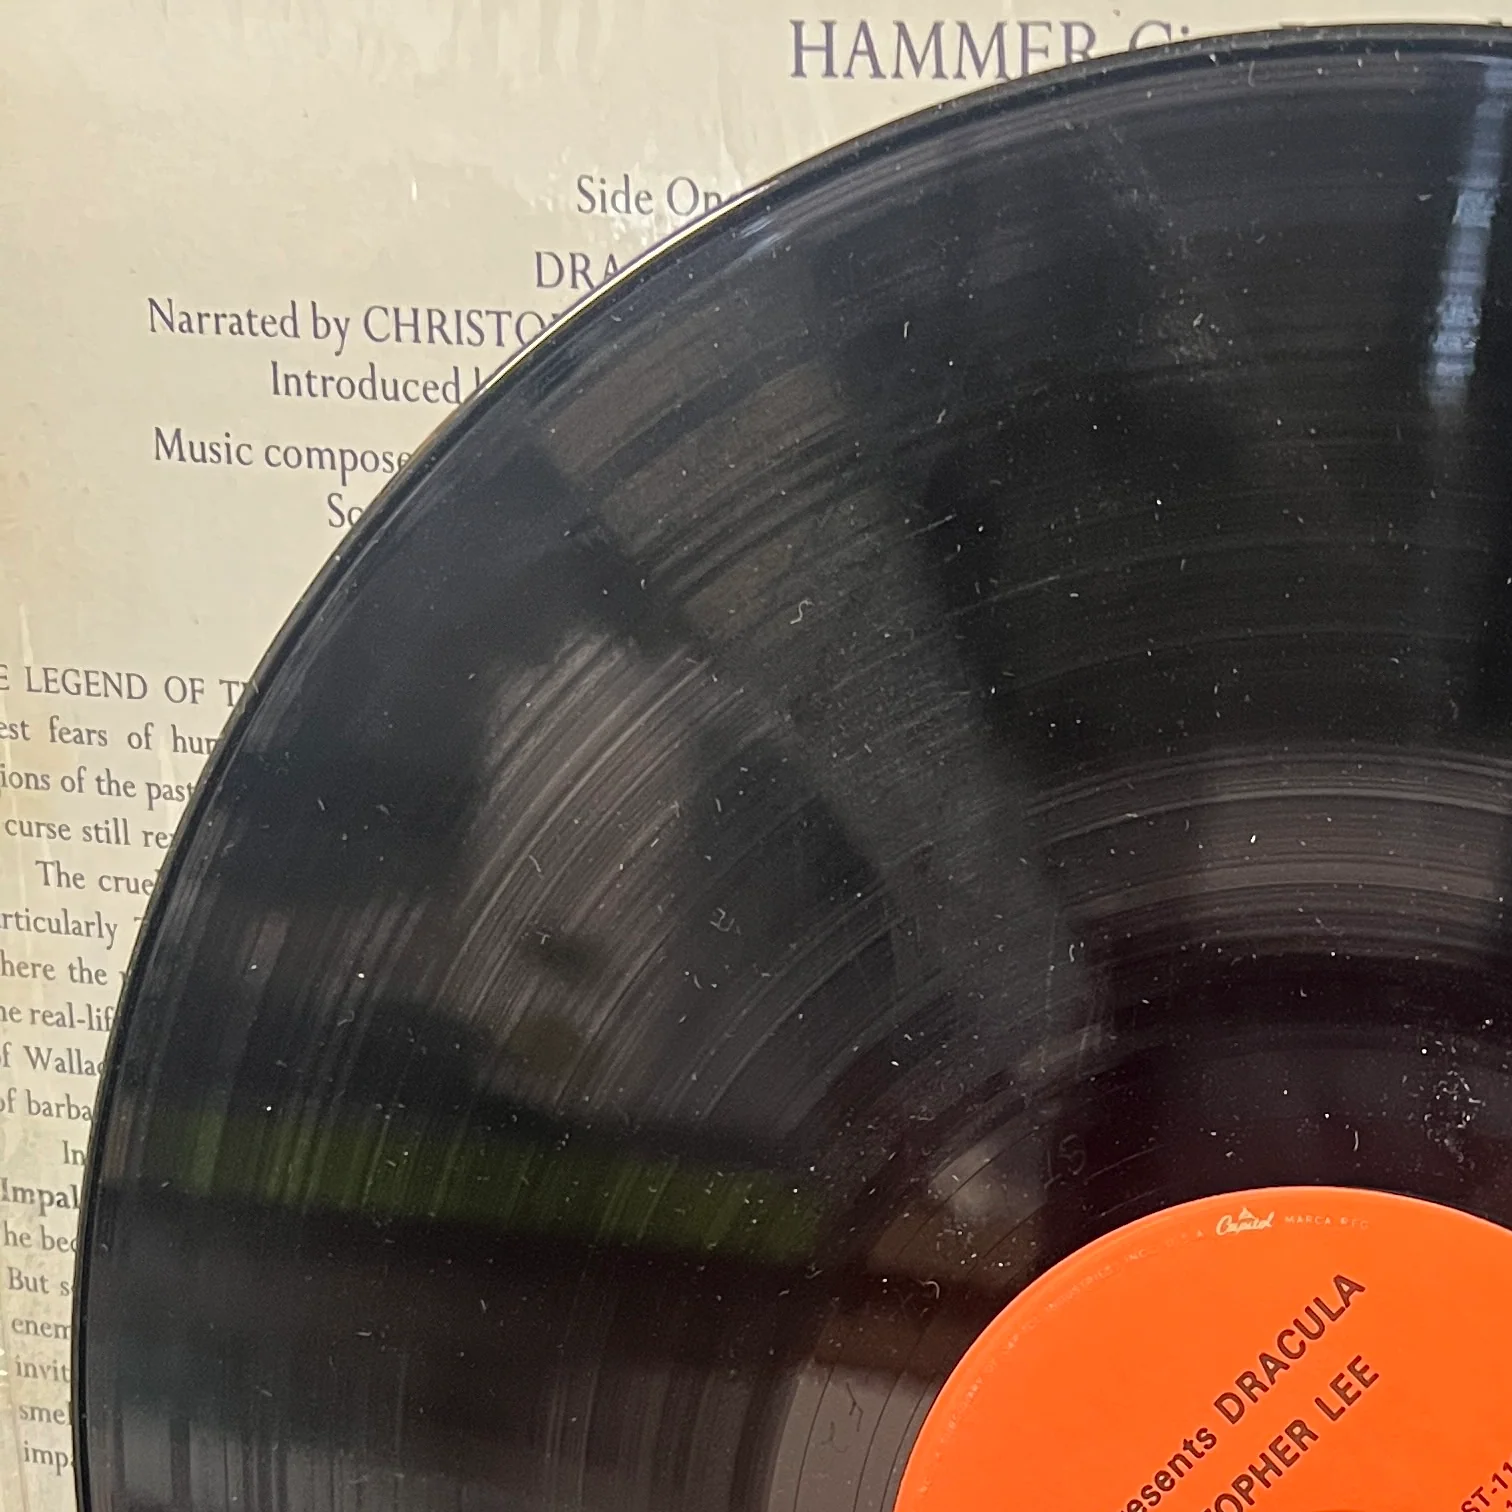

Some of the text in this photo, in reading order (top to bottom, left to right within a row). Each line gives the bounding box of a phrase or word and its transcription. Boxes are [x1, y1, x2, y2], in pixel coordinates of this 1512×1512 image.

[576, 173, 654, 215] Side
[148, 297, 300, 341] Narrated
[311, 302, 351, 356] by
[270, 362, 462, 404] Introduced
[153, 427, 254, 468] Music
[25, 666, 205, 705] LEGEND OF
[49, 715, 154, 750] fears of
[60, 765, 87, 794] of
[95, 768, 137, 798] the
[4, 817, 131, 846] curse still
[35, 860, 86, 890] The
[67, 956, 108, 986] the
[7, 1266, 49, 1294] But
[1213, 1273, 1366, 1425] DRACULA
[1313, 1354, 1380, 1422] LEE
